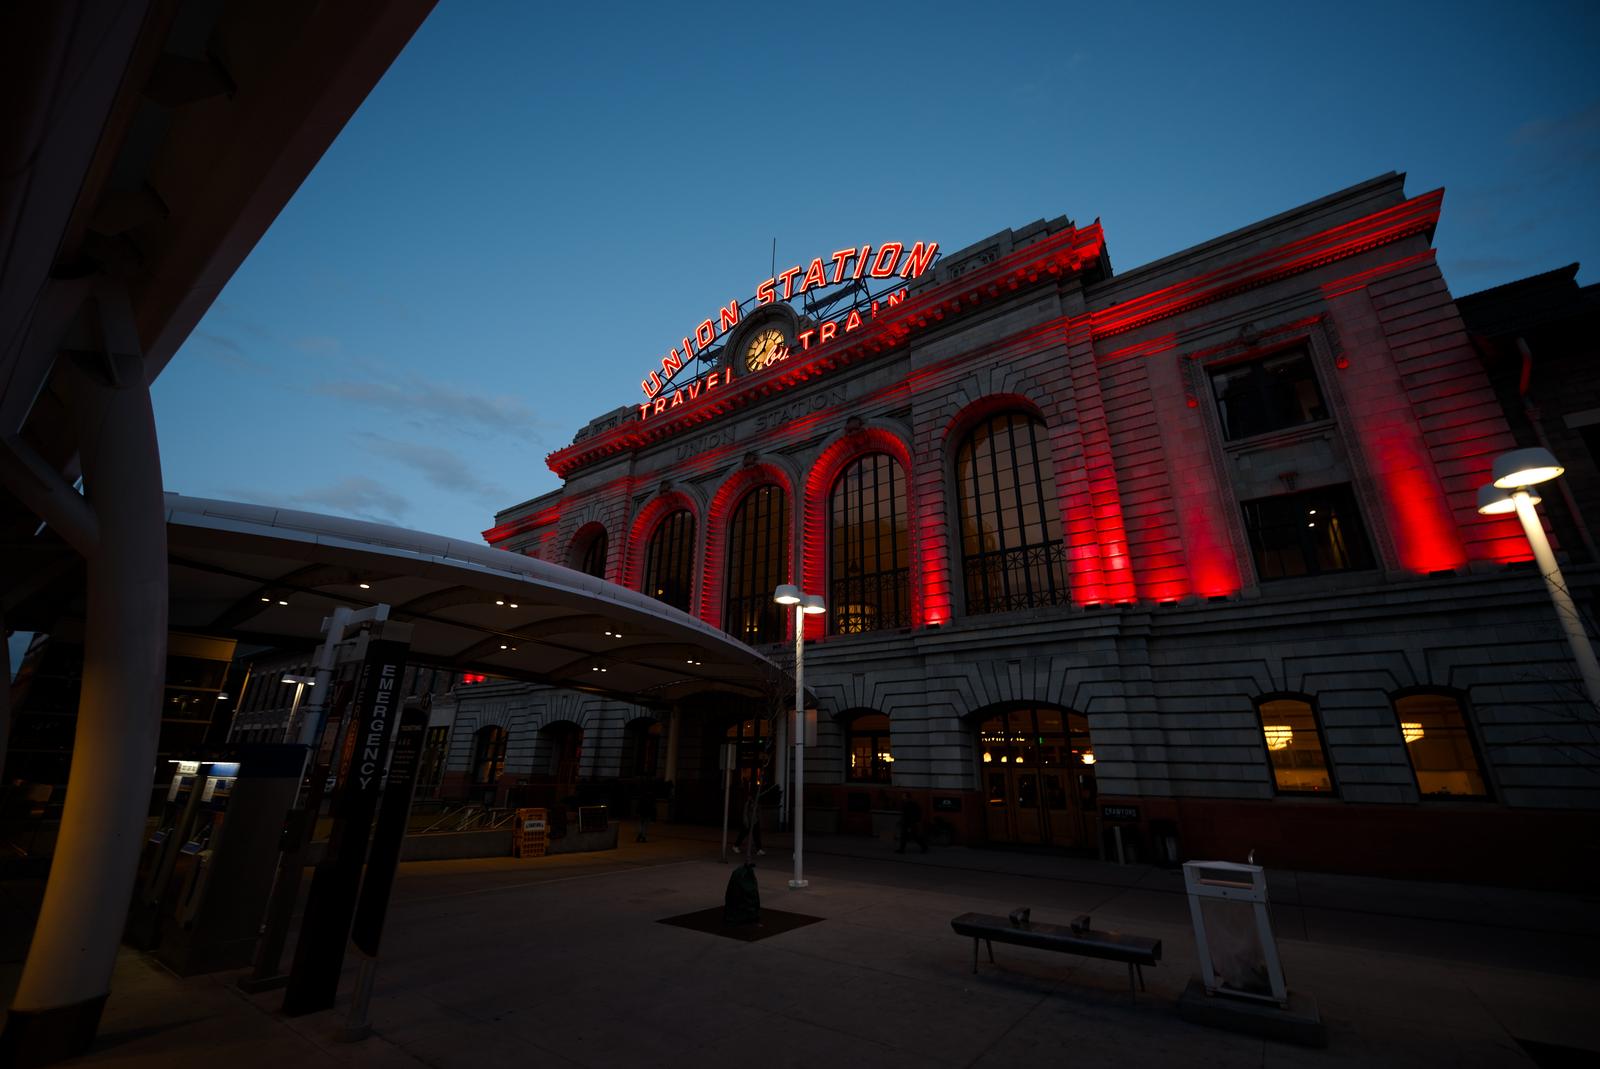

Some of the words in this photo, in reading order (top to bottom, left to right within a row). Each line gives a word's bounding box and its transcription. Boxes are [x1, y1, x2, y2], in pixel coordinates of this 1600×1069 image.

[641, 300, 740, 399] UNION
[756, 242, 938, 307] STATION
[799, 287, 908, 350] TRAIN
[677, 423, 736, 460] UNION
[755, 385, 847, 433] STATION
[360, 664, 397, 790] EMERGENCY
